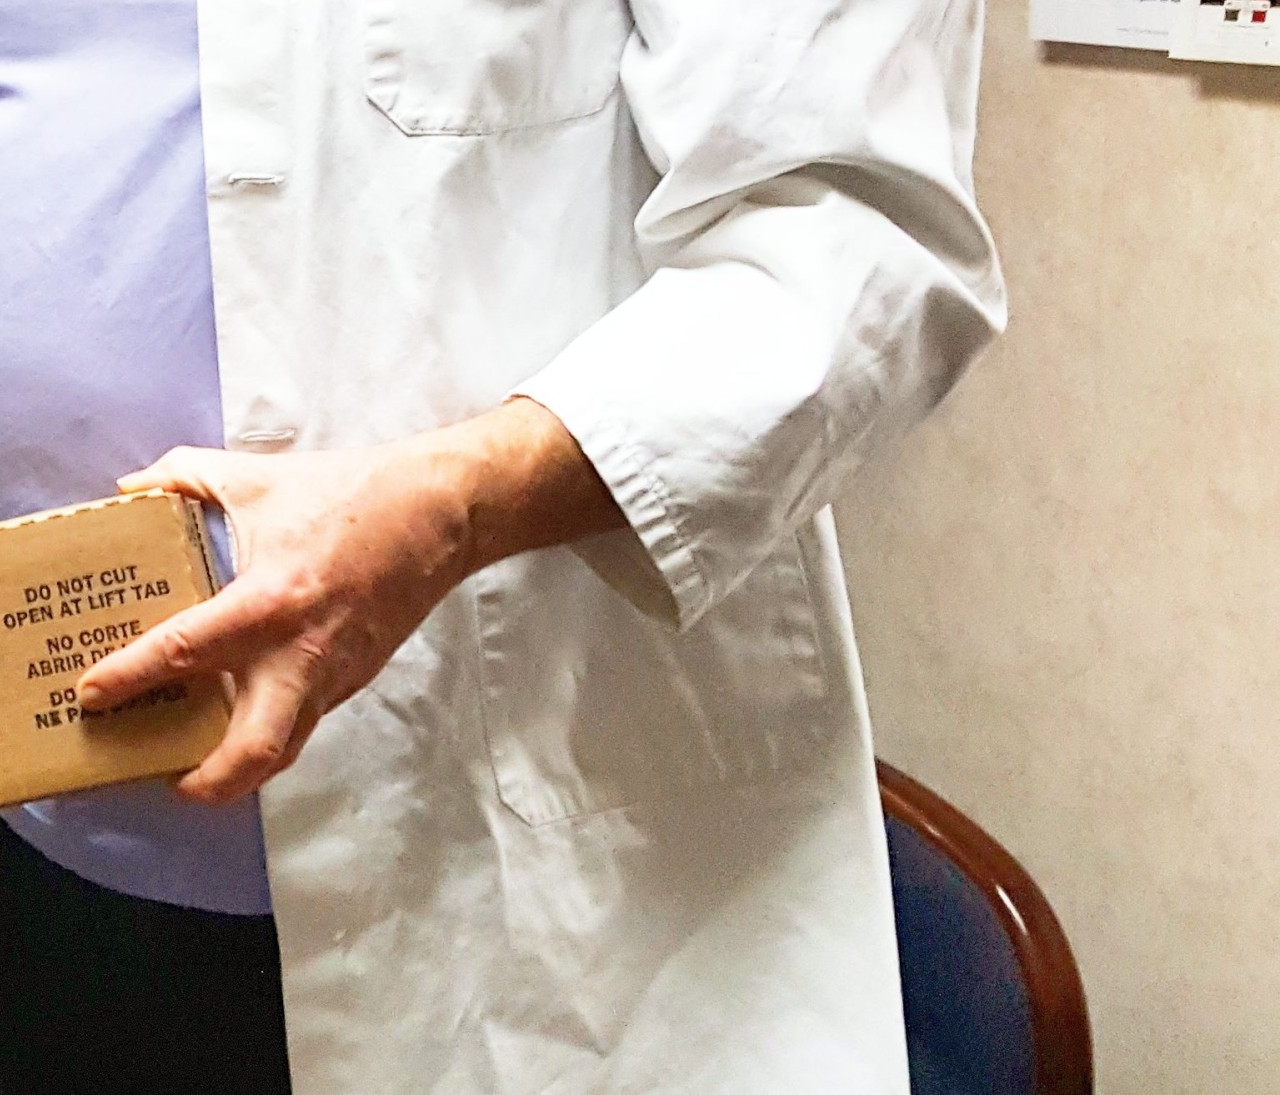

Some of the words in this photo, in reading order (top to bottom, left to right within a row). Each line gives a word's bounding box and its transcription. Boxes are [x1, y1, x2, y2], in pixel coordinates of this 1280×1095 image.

[24, 584, 51, 603] DO
[57, 573, 94, 596] NOT
[100, 565, 138, 586] CUT
[3, 605, 54, 630] OPEN
[59, 598, 82, 618] AT
[88, 588, 126, 610] LIFT
[131, 579, 170, 601] TAB
[46, 635, 74, 655] NO
[79, 620, 143, 646] CORTE
[27, 653, 86, 679] ABRIR
[50, 687, 77, 707] DO
[34, 709, 63, 729] NE
